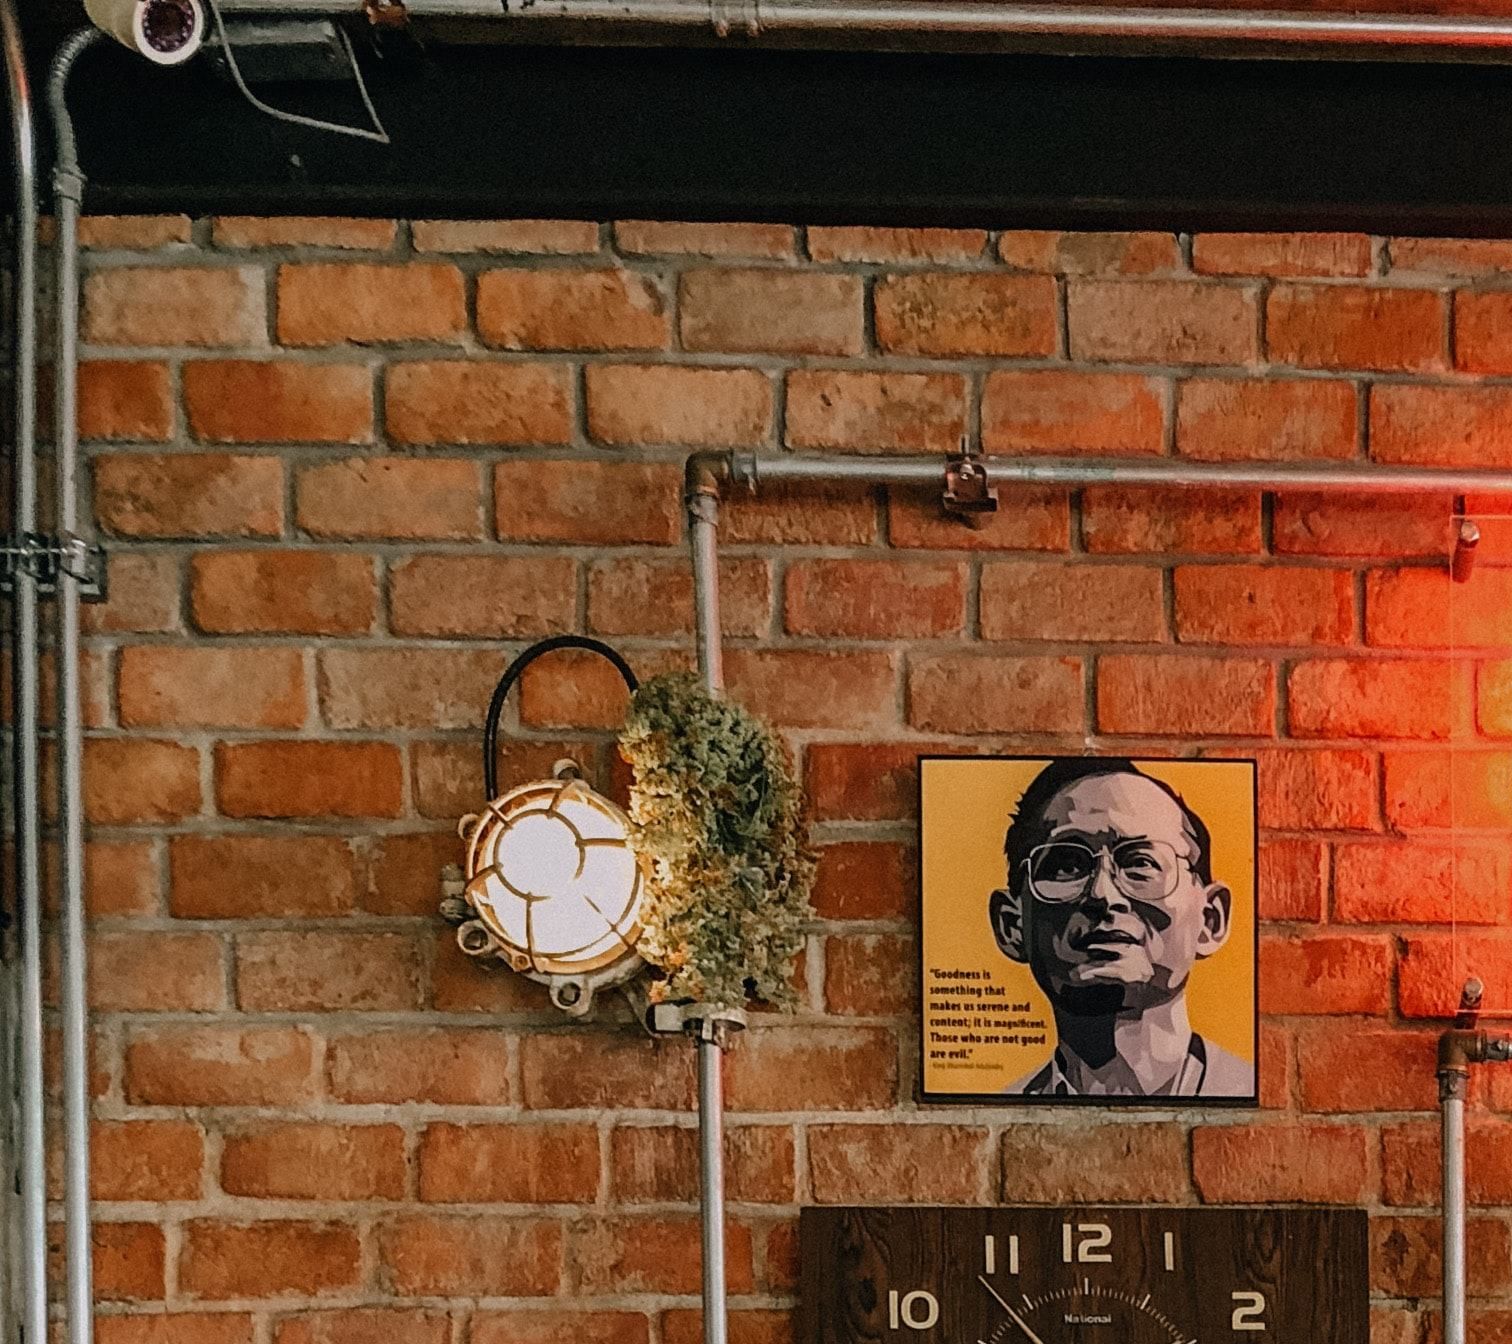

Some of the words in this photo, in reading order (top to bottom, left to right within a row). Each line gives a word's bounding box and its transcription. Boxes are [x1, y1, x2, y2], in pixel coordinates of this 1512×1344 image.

[983, 969, 991, 980] is
[930, 985, 982, 998] something
[985, 986, 1005, 996] that
[930, 1000, 961, 1011] makes
[964, 1003, 974, 1011] us
[977, 1003, 1009, 1012] serene
[1012, 1002, 1030, 1012] and
[974, 1018, 981, 1027] it
[984, 1018, 991, 1028] is
[930, 1032, 958, 1043] Those
[961, 1033, 981, 1043] who
[984, 1036, 999, 1044] are
[1002, 1036, 1019, 1044] not
[1021, 1034, 1046, 1046] good
[930, 1050, 946, 1058] are
[1062, 1223, 1112, 1263] 12
[985, 1235, 1019, 1274] 11
[1164, 1231, 1175, 1271] 1
[889, 1290, 939, 1330] 10
[1231, 1291, 1266, 1331] 2
[1064, 1313, 1112, 1324] National
